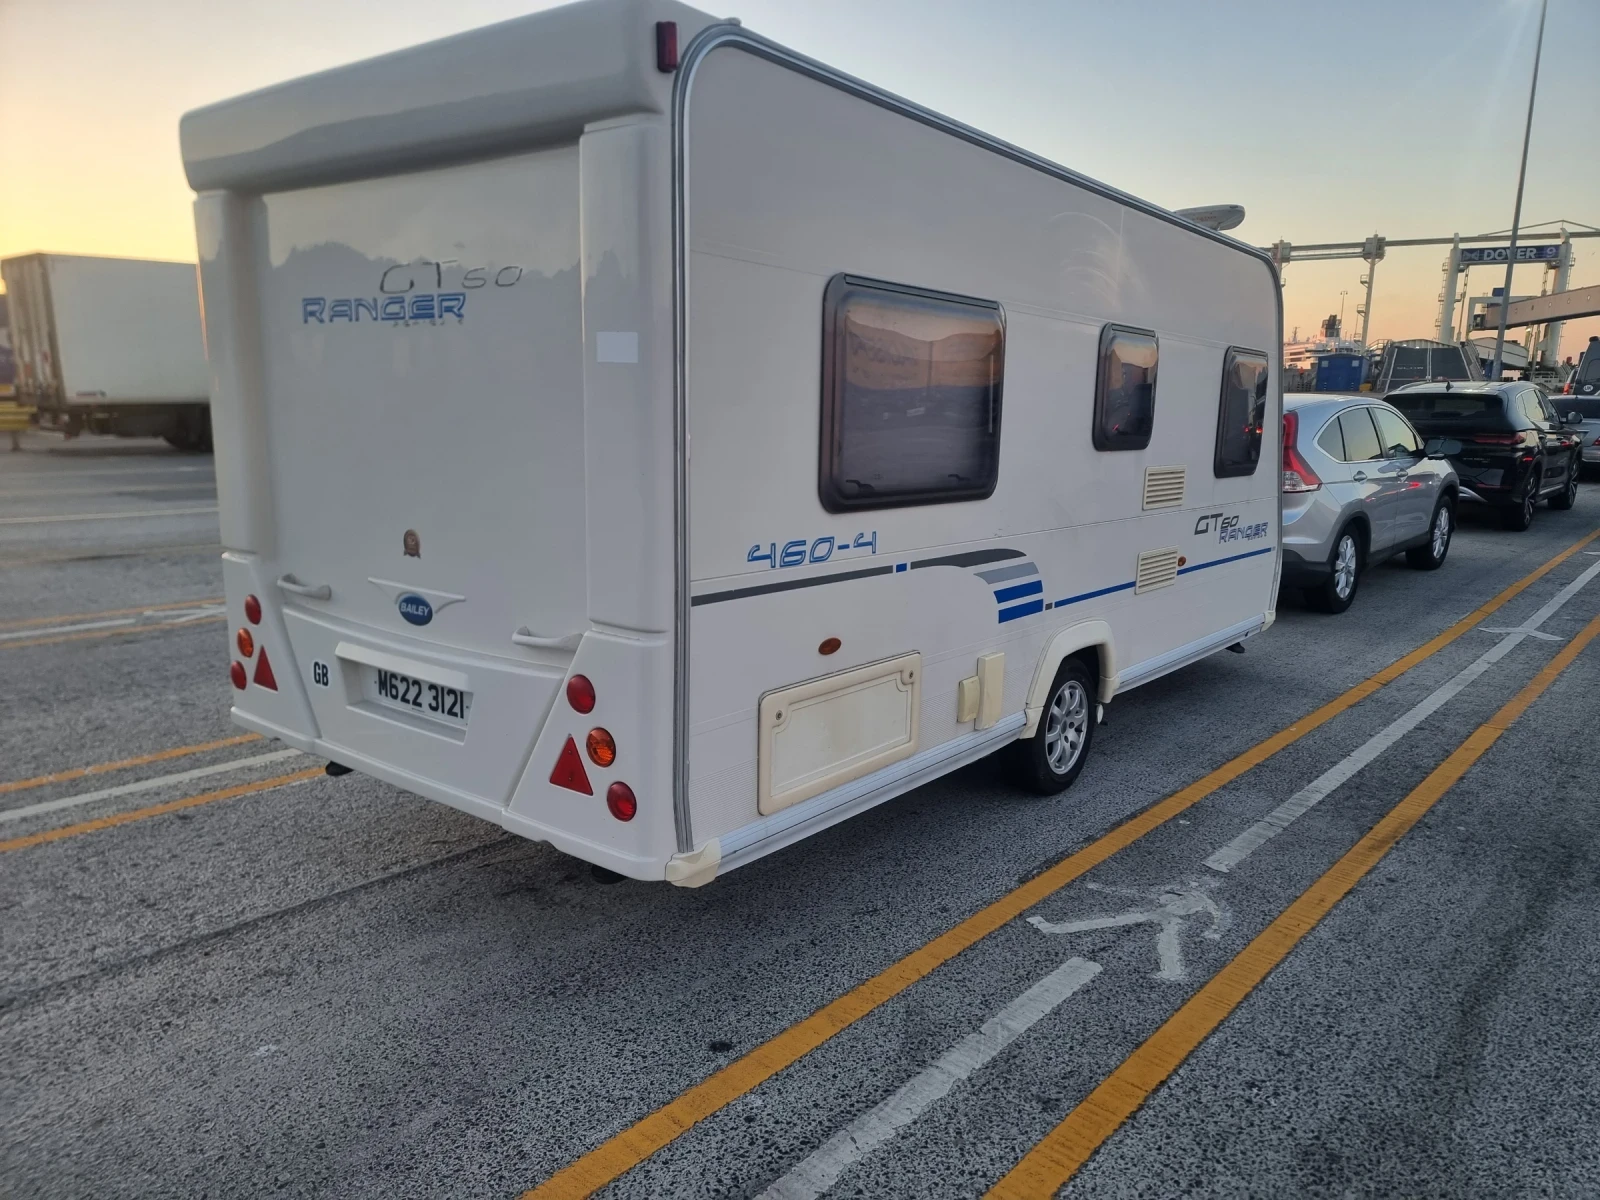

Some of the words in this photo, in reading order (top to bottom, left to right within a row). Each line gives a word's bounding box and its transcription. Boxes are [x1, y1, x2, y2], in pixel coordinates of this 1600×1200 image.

[1546, 246, 1556, 258] 9
[302, 292, 467, 324] RANGER
[1218, 521, 1269, 545] RANGER
[747, 530, 877, 568] 460-4
[400, 601, 430, 617] BAILEY
[313, 661, 329, 687] GB
[377, 669, 423, 708] M622
[427, 683, 465, 719] 3121
